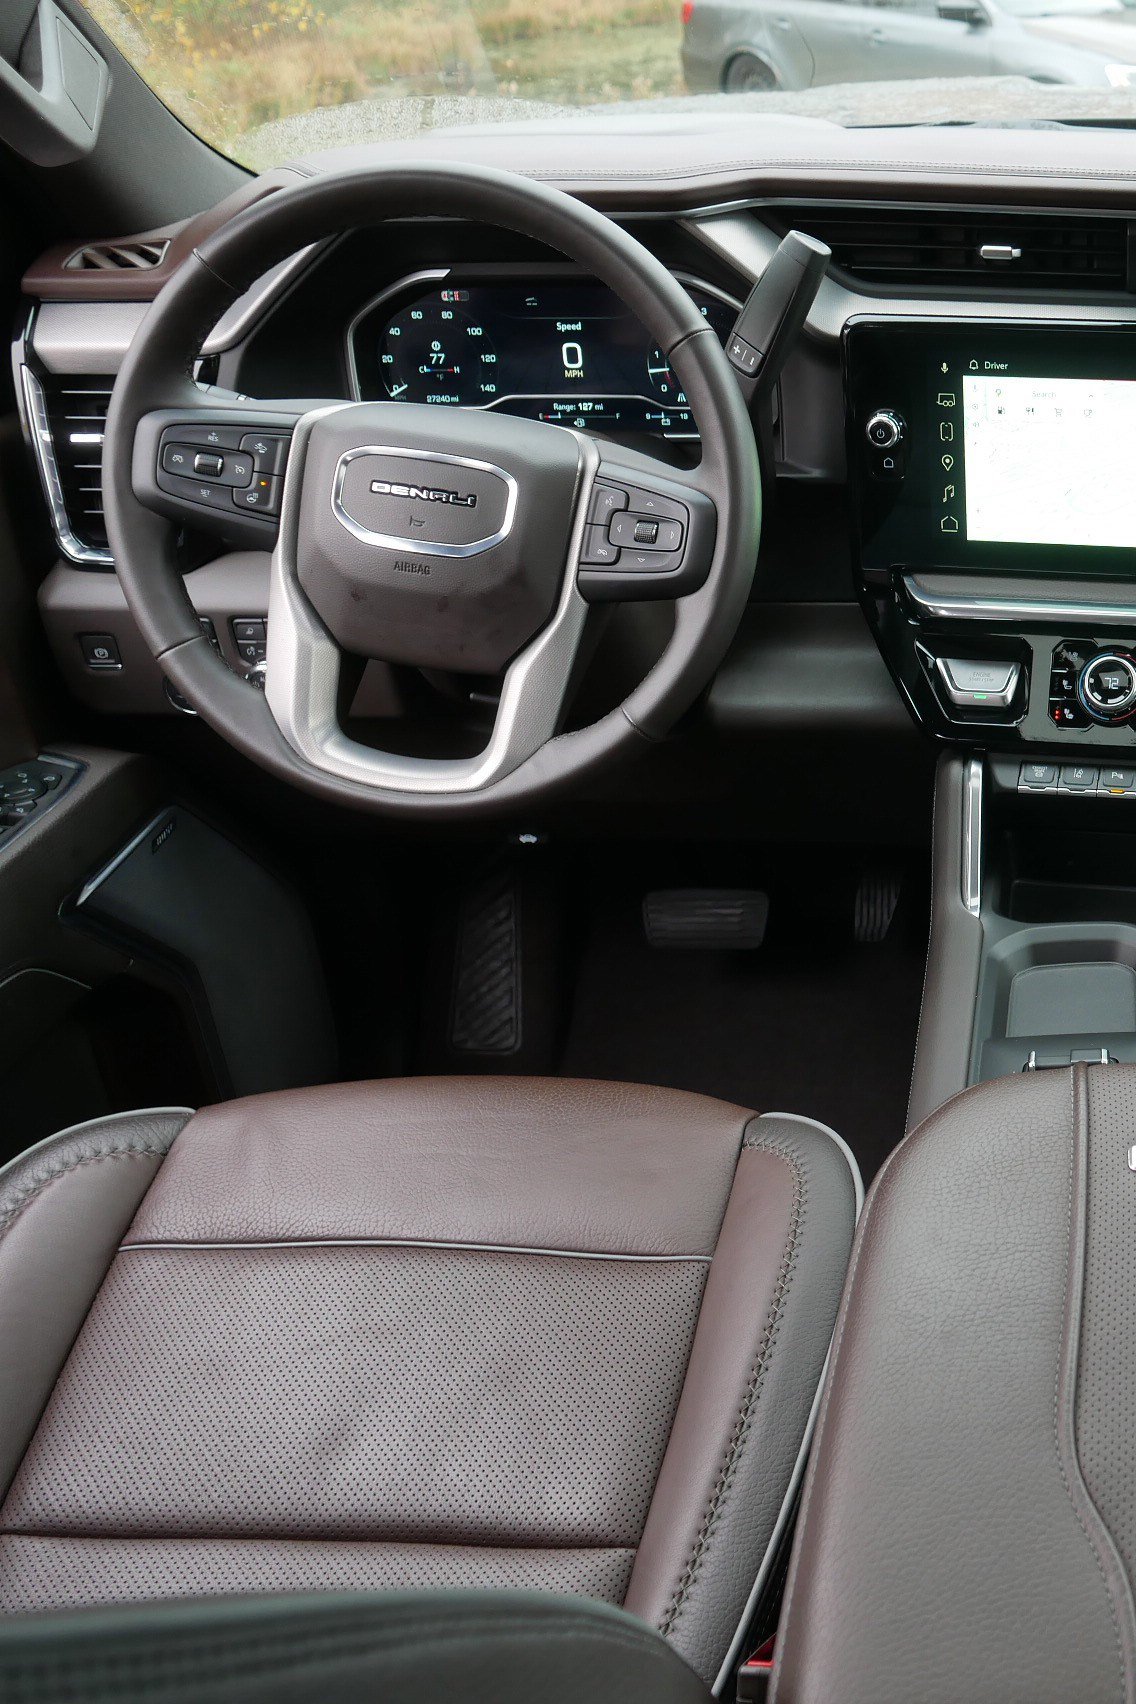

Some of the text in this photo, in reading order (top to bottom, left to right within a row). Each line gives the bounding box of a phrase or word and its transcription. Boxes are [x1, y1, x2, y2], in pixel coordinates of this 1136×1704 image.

[411, 311, 423, 319] 60
[441, 311, 453, 319] 80
[700, 307, 707, 315] 3
[466, 327, 483, 335] 100
[556, 321, 582, 332] Speed
[389, 327, 400, 336] 40
[382, 354, 393, 363] 20
[480, 354, 496, 362] 120
[562, 342, 583, 369] 0
[655, 350, 659, 358] 1
[429, 353, 445, 365] 77
[984, 361, 1008, 370] Driver
[564, 370, 584, 378] MPH
[480, 384, 496, 392] 140
[661, 384, 668, 392] 0
[1032, 390, 1057, 399] Search
[553, 402, 576, 412] Range:
[578, 402, 593, 410] 127
[370, 479, 477, 508] DENALI
[393, 560, 431, 575] AIRBAG
[1104, 677, 1119, 689] 72
